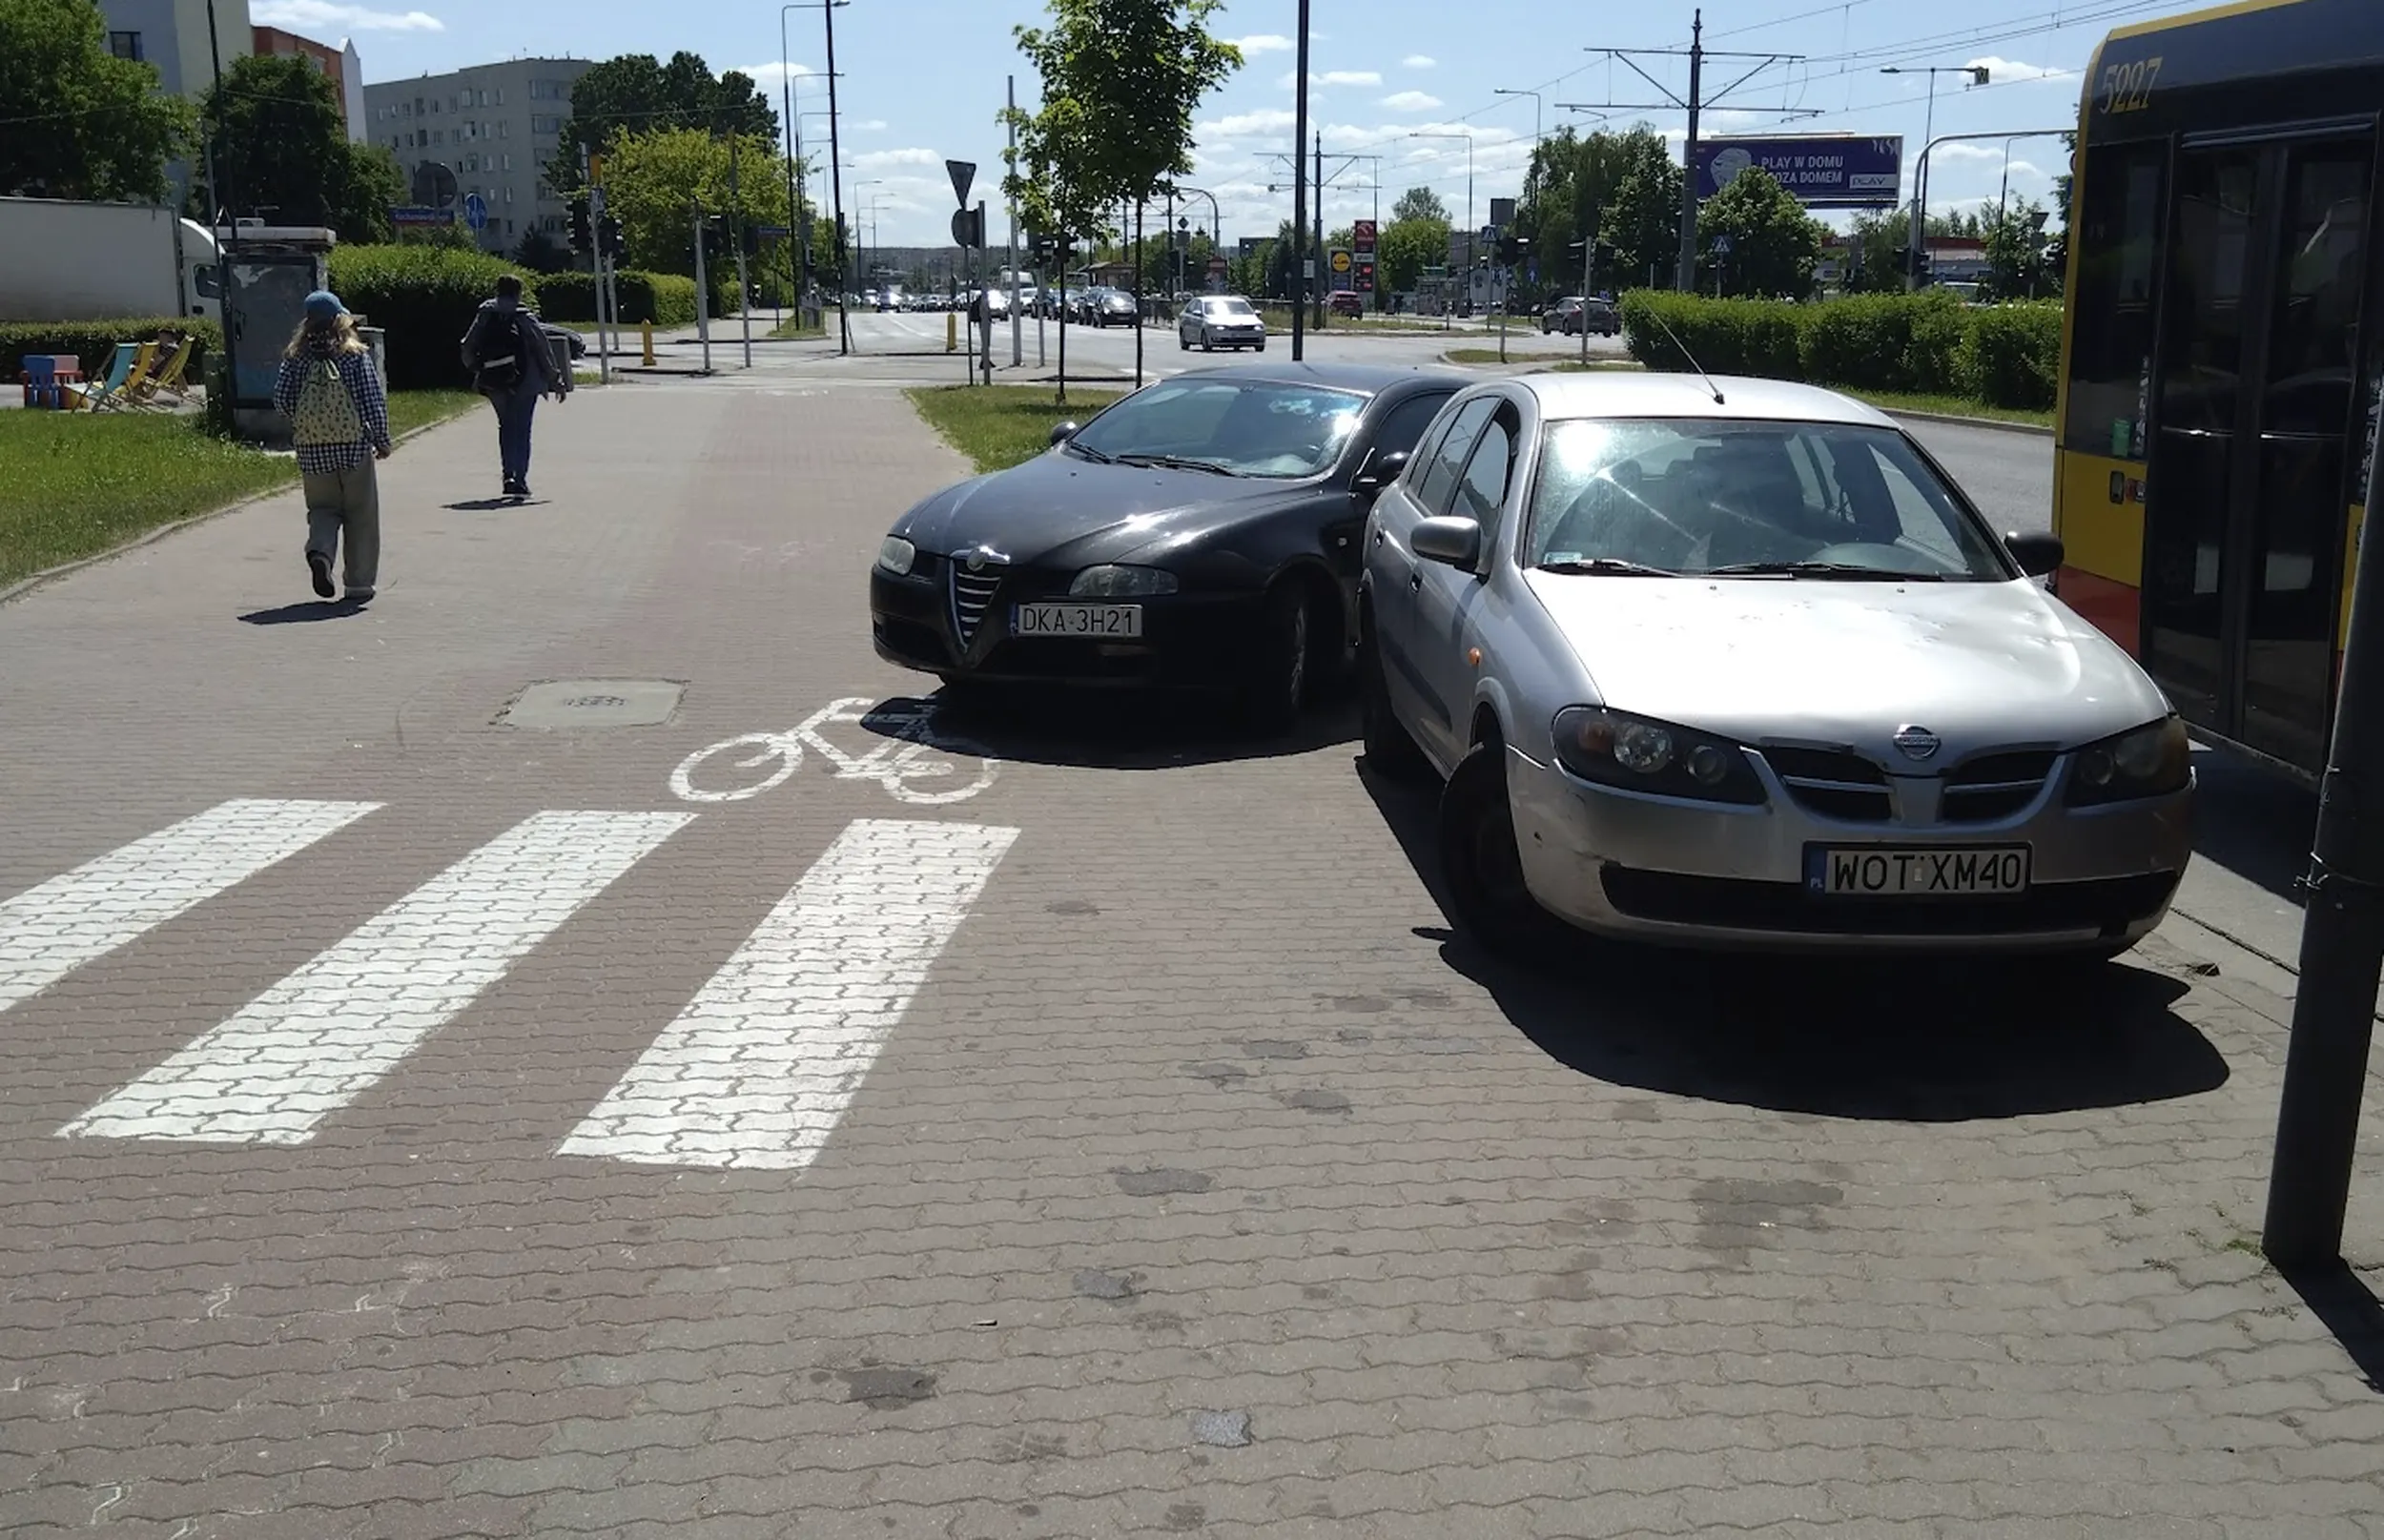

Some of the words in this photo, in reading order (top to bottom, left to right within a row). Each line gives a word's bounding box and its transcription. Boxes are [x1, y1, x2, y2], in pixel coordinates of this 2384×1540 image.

[2099, 56, 2164, 114] 5227
[1761, 156, 1792, 170] PLAY
[1794, 156, 1805, 169] W
[1808, 155, 1843, 169] DOMU
[1771, 171, 1798, 184] OZA
[1799, 171, 1842, 184] DOMEM
[1023, 607, 1066, 632] DKA
[1076, 608, 1133, 634] 3H21
[1833, 853, 1916, 891] WOT
[1927, 853, 2021, 891] XM40
